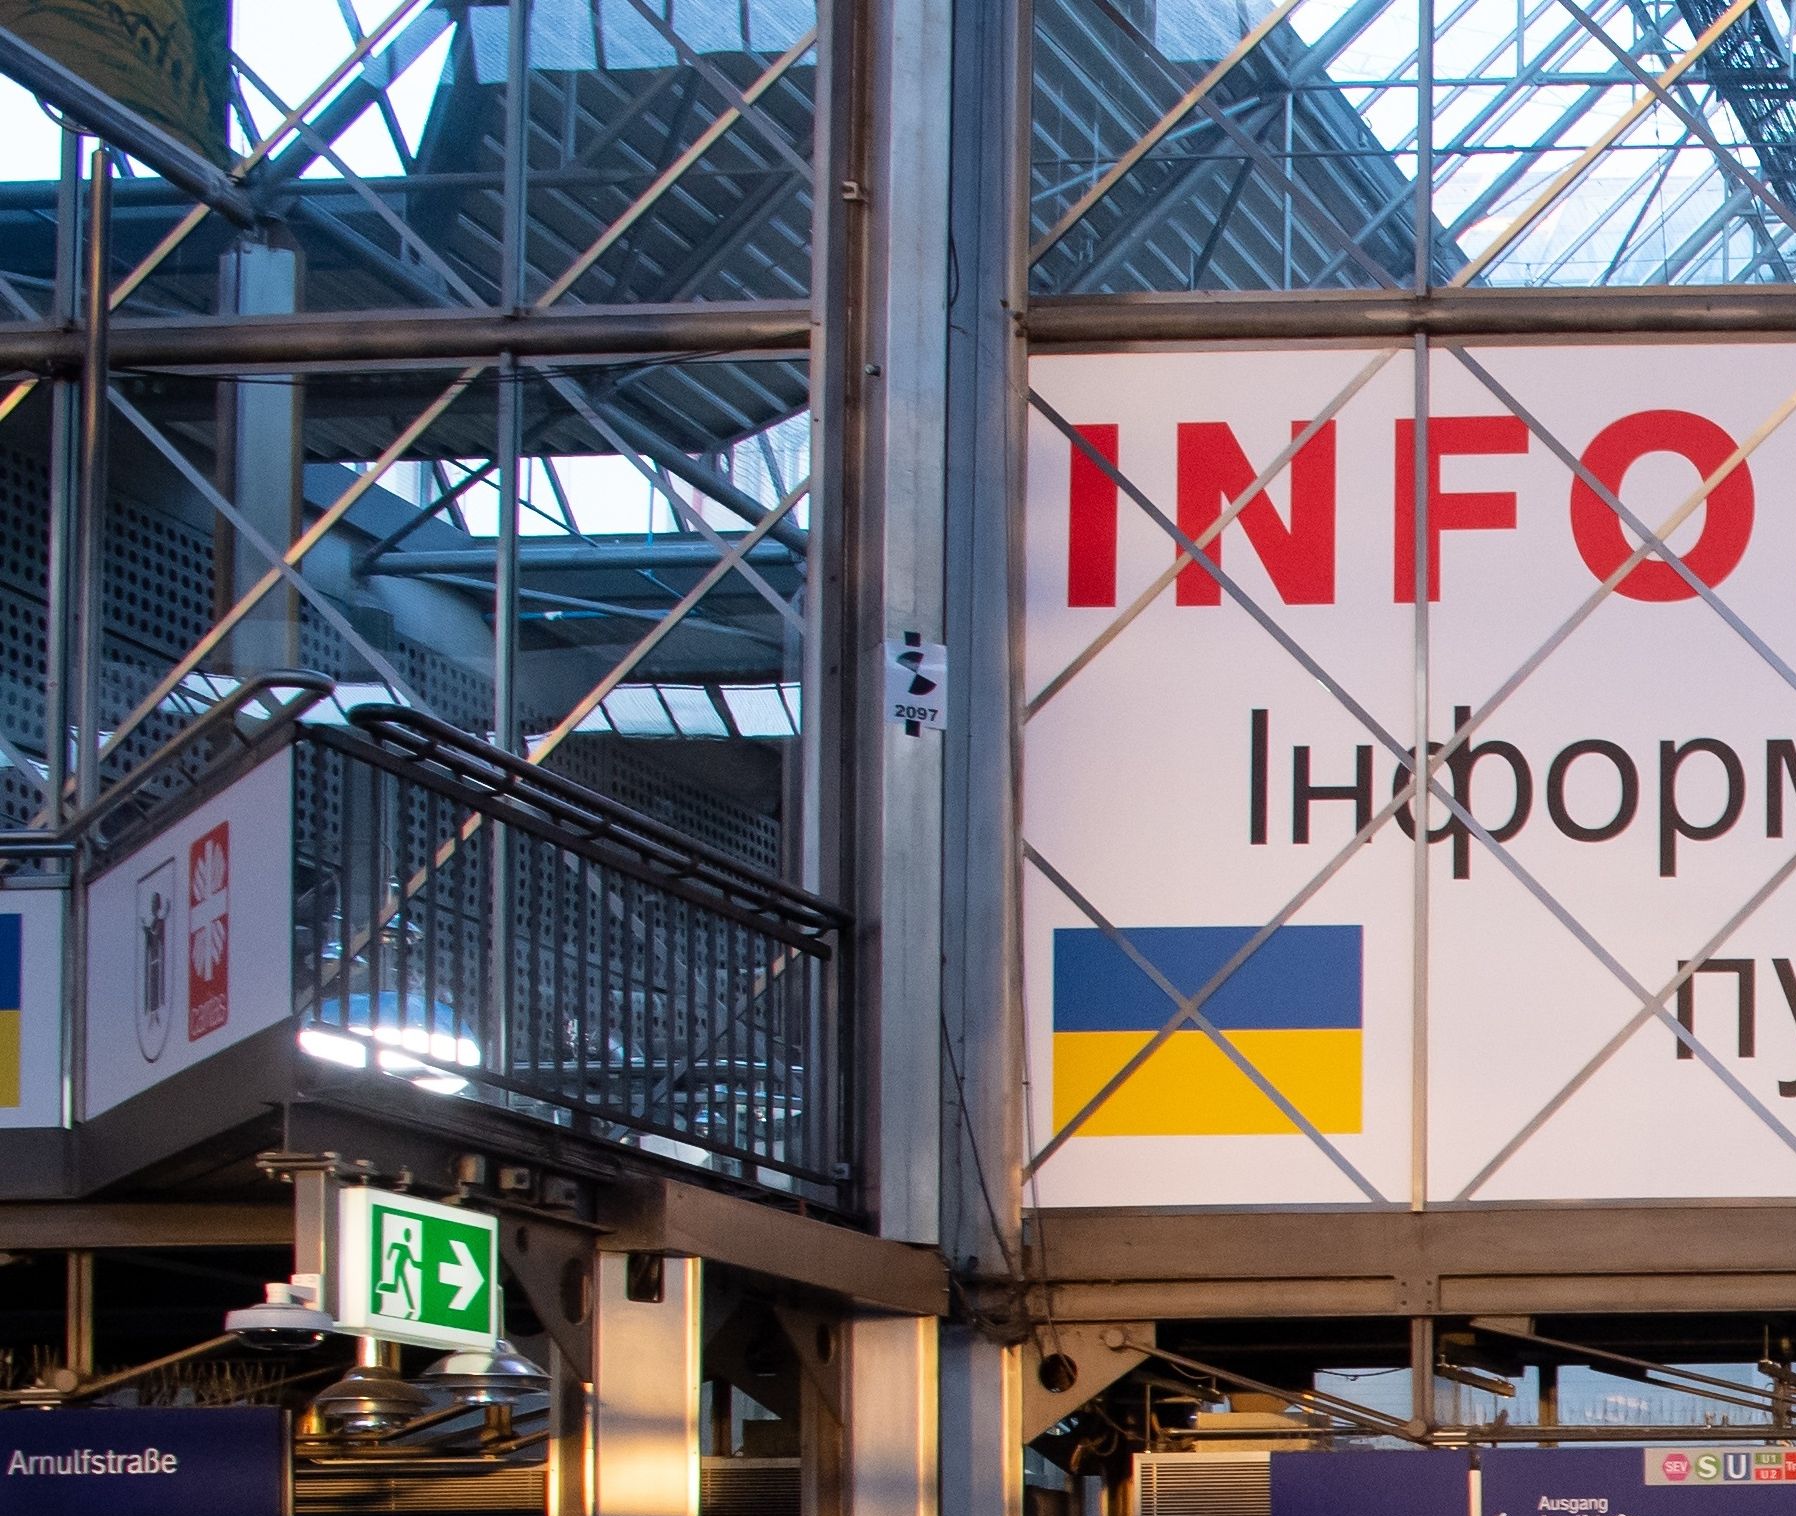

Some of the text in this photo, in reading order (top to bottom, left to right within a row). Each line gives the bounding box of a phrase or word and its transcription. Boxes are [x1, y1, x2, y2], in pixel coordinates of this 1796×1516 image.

[894, 704, 939, 721] 2097
[7, 1447, 178, 1476] Arnulfstraße
[1664, 1460, 1688, 1473] SEV
[1538, 1495, 1609, 1514] Ausgang
